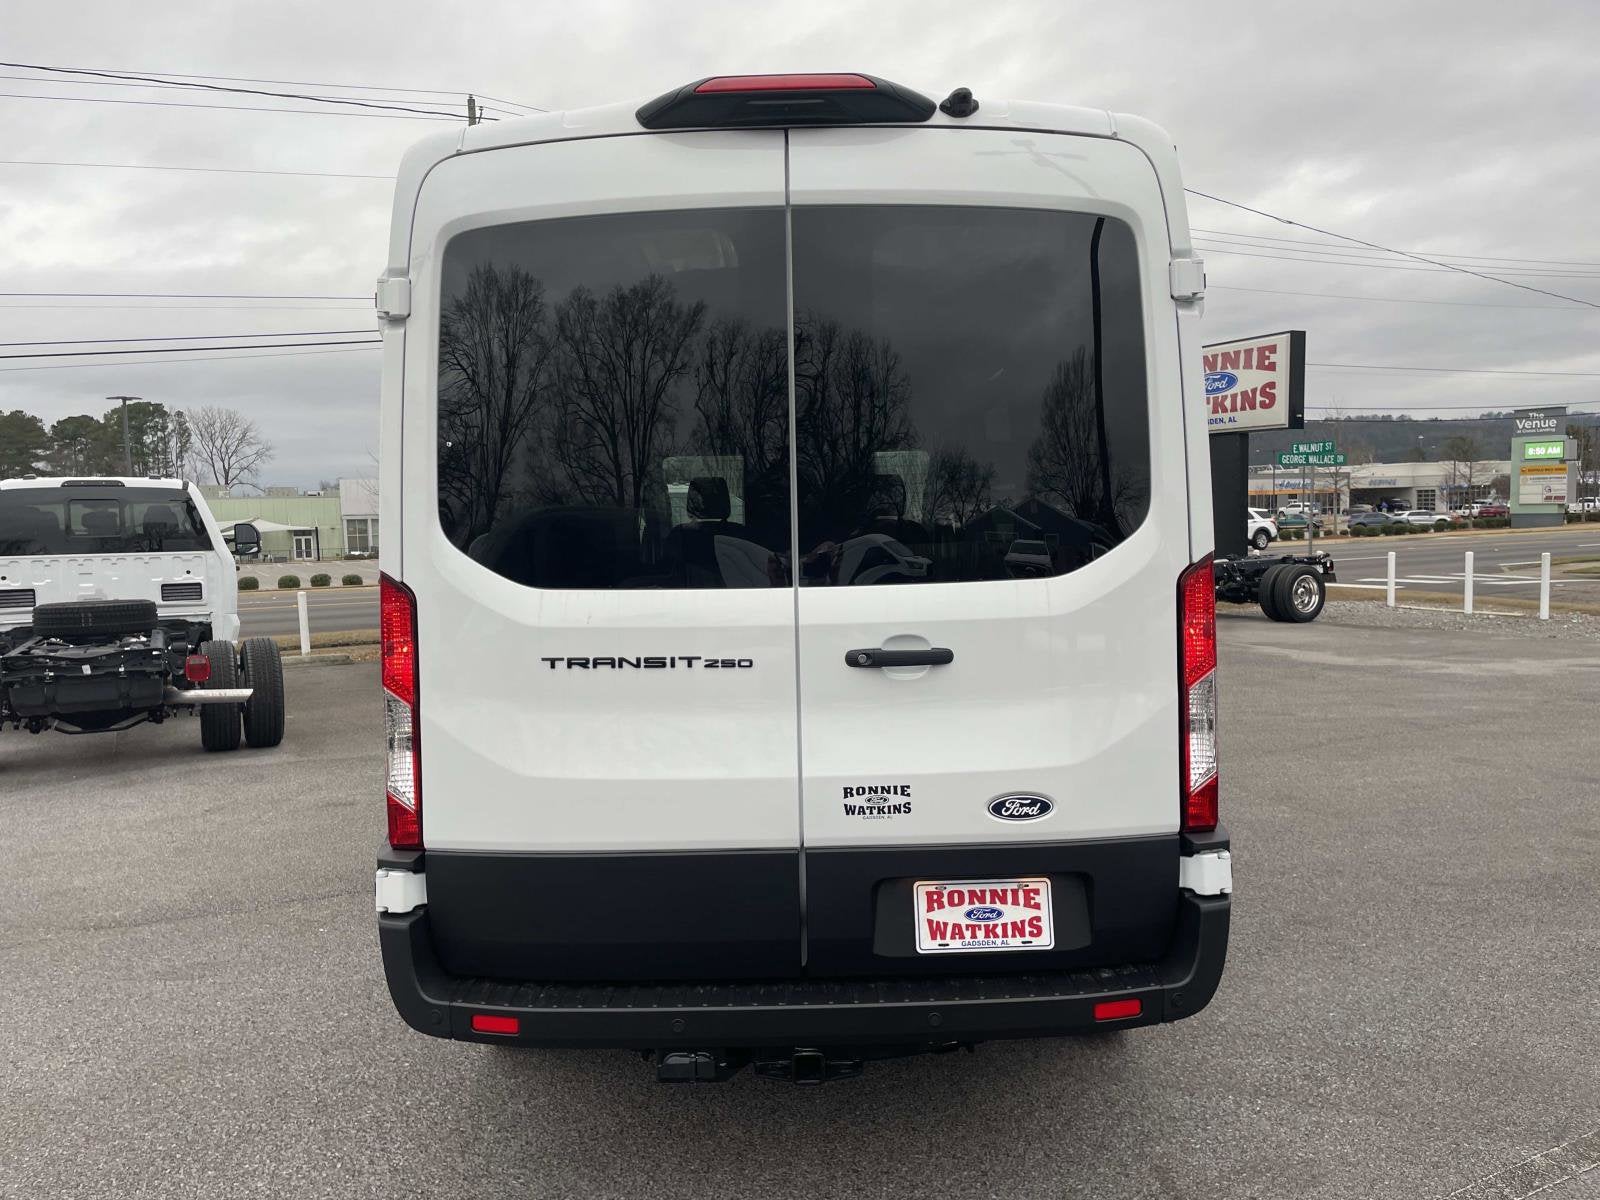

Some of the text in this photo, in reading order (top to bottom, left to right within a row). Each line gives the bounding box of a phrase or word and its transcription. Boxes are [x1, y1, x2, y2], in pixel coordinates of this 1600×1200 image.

[1203, 344, 1277, 372] NNIE
[1206, 381, 1276, 414] KINS
[1516, 419, 1557, 429] Venue
[1299, 442, 1324, 453] WALNUT
[1325, 442, 1332, 450] ST
[1528, 446, 1561, 456] 8:50 AM
[1282, 455, 1344, 464] GEORGE WALLACE DR
[541, 655, 754, 670] TRANSIT 250
[843, 785, 911, 799] RONNIE
[844, 802, 912, 816] WATKINS
[1002, 795, 1040, 816] Ford
[925, 888, 1041, 913] RONNIE
[970, 908, 998, 921] Ford
[927, 916, 1043, 941] WATKINS
